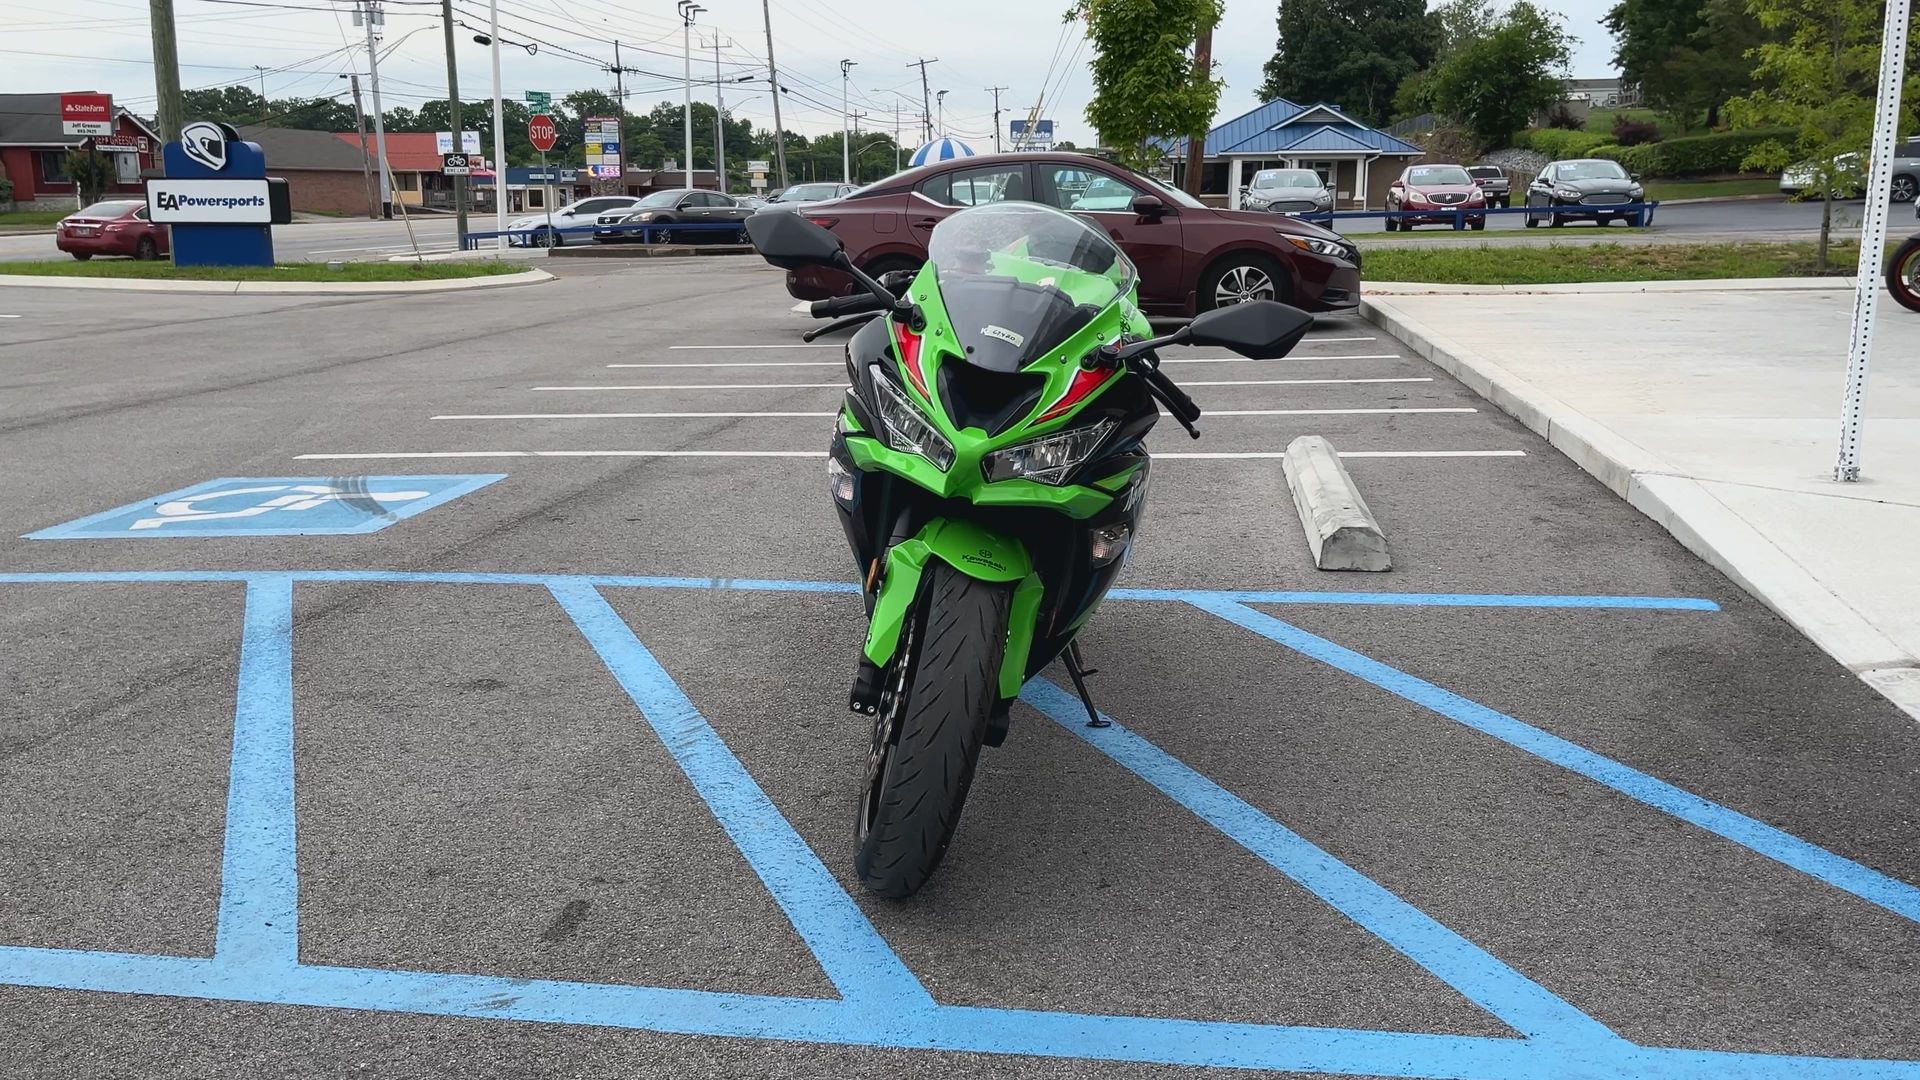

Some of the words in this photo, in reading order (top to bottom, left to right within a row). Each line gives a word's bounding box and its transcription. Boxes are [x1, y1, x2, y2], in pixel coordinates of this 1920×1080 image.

[531, 125, 554, 139] STOP
[598, 166, 621, 175] LESS
[962, 554, 1006, 572] Kawasaki
